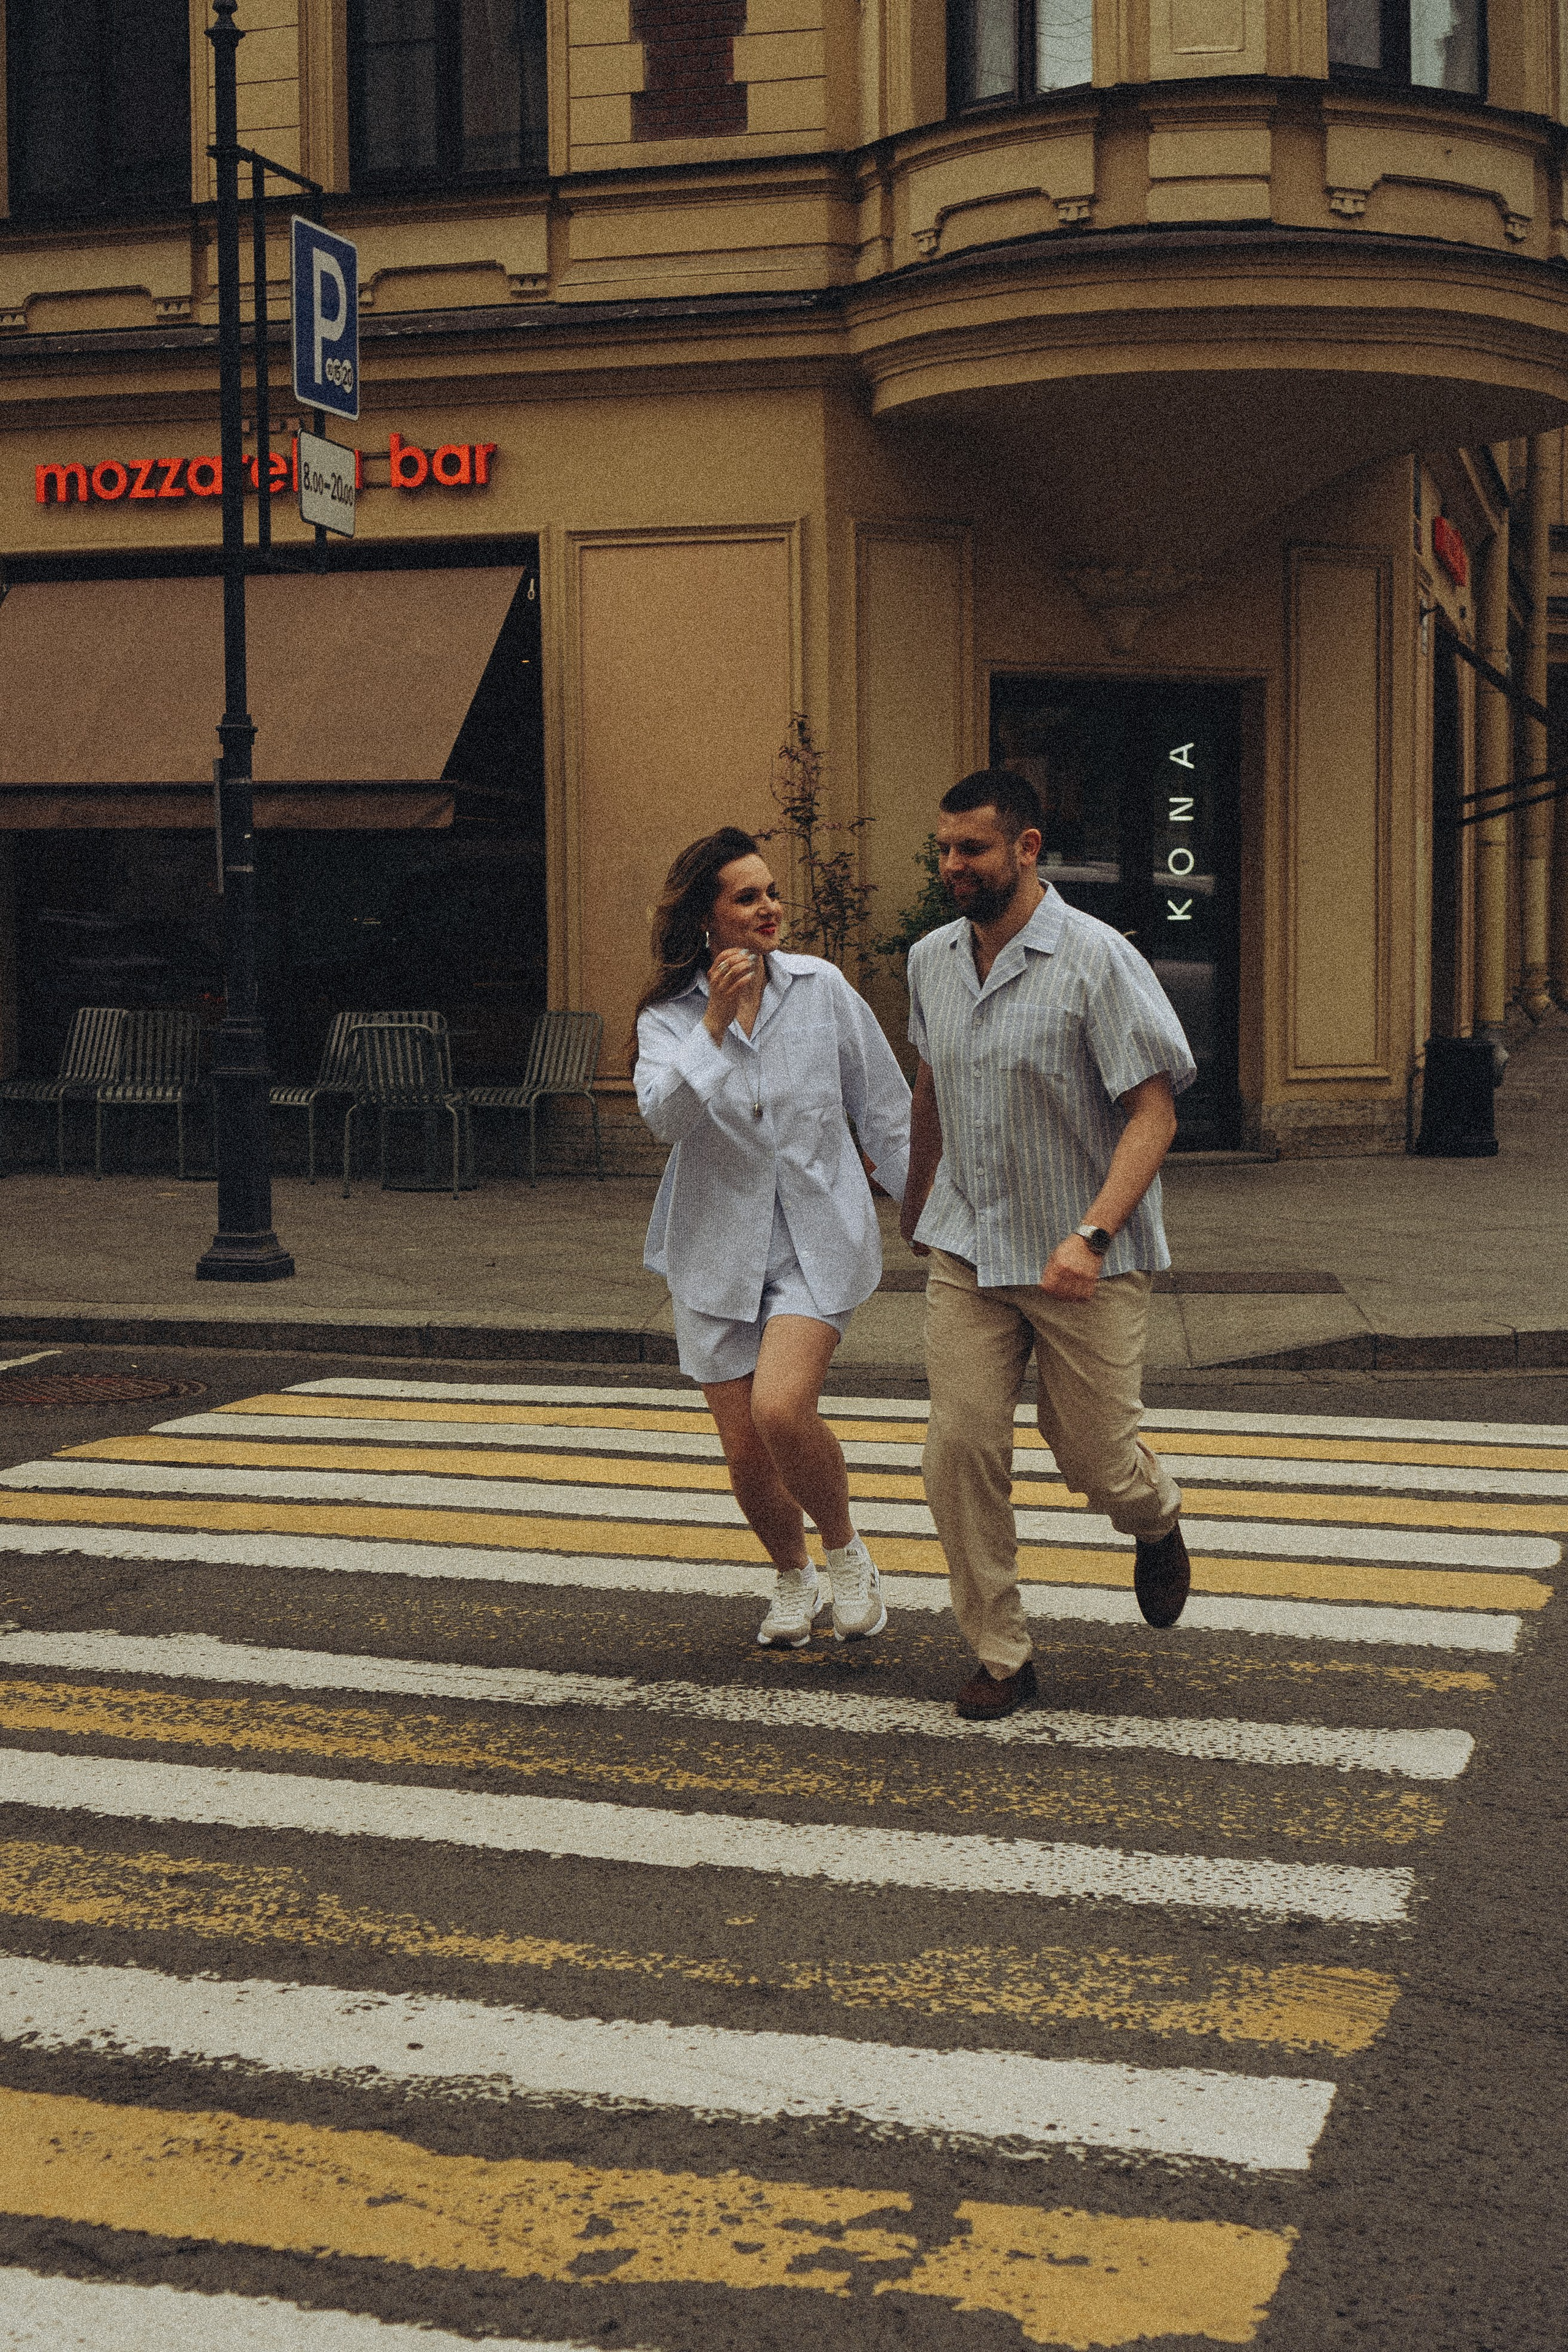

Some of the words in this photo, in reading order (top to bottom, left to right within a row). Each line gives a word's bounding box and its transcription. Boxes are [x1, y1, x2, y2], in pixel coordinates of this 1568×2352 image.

[312, 247, 347, 385] P
[35, 437, 361, 503] mozzael
[390, 432, 496, 488] bar
[1167, 742, 1194, 921] KONA
